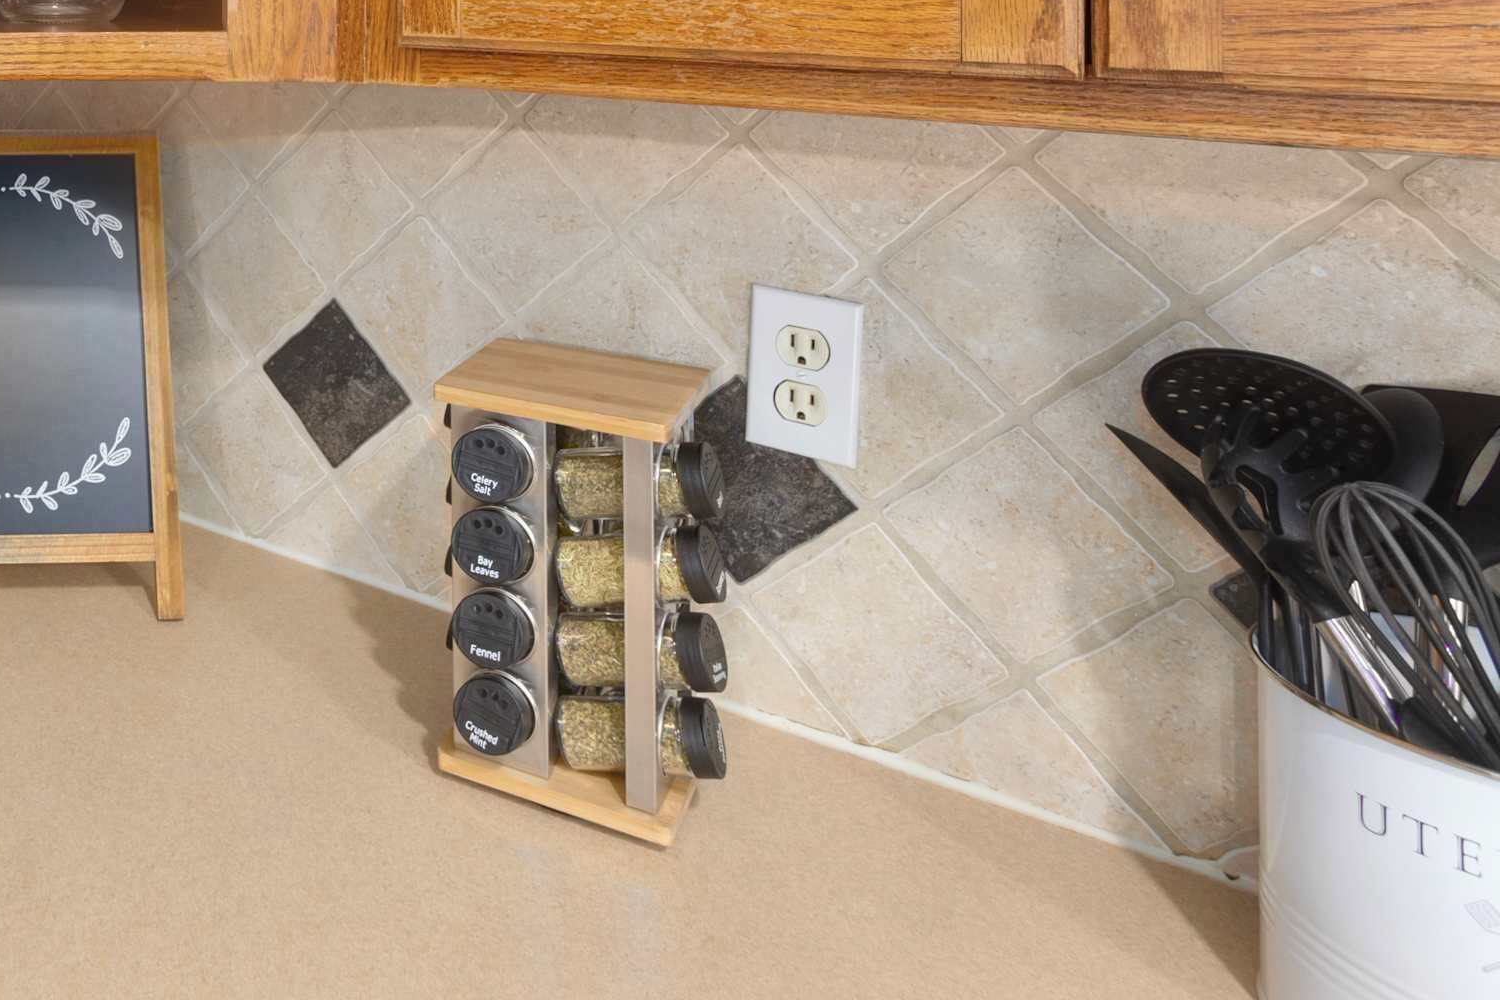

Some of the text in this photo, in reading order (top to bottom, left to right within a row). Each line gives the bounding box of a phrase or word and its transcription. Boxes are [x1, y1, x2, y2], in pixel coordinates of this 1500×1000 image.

[471, 472, 498, 489] Celery
[474, 483, 492, 496] Salt
[478, 555, 493, 568] Bay
[470, 563, 499, 579] Leaves
[470, 644, 500, 662] Fennel
[465, 720, 498, 746] Crushed
[469, 732, 487, 750] Mint
[1355, 791, 1500, 878] UTE
